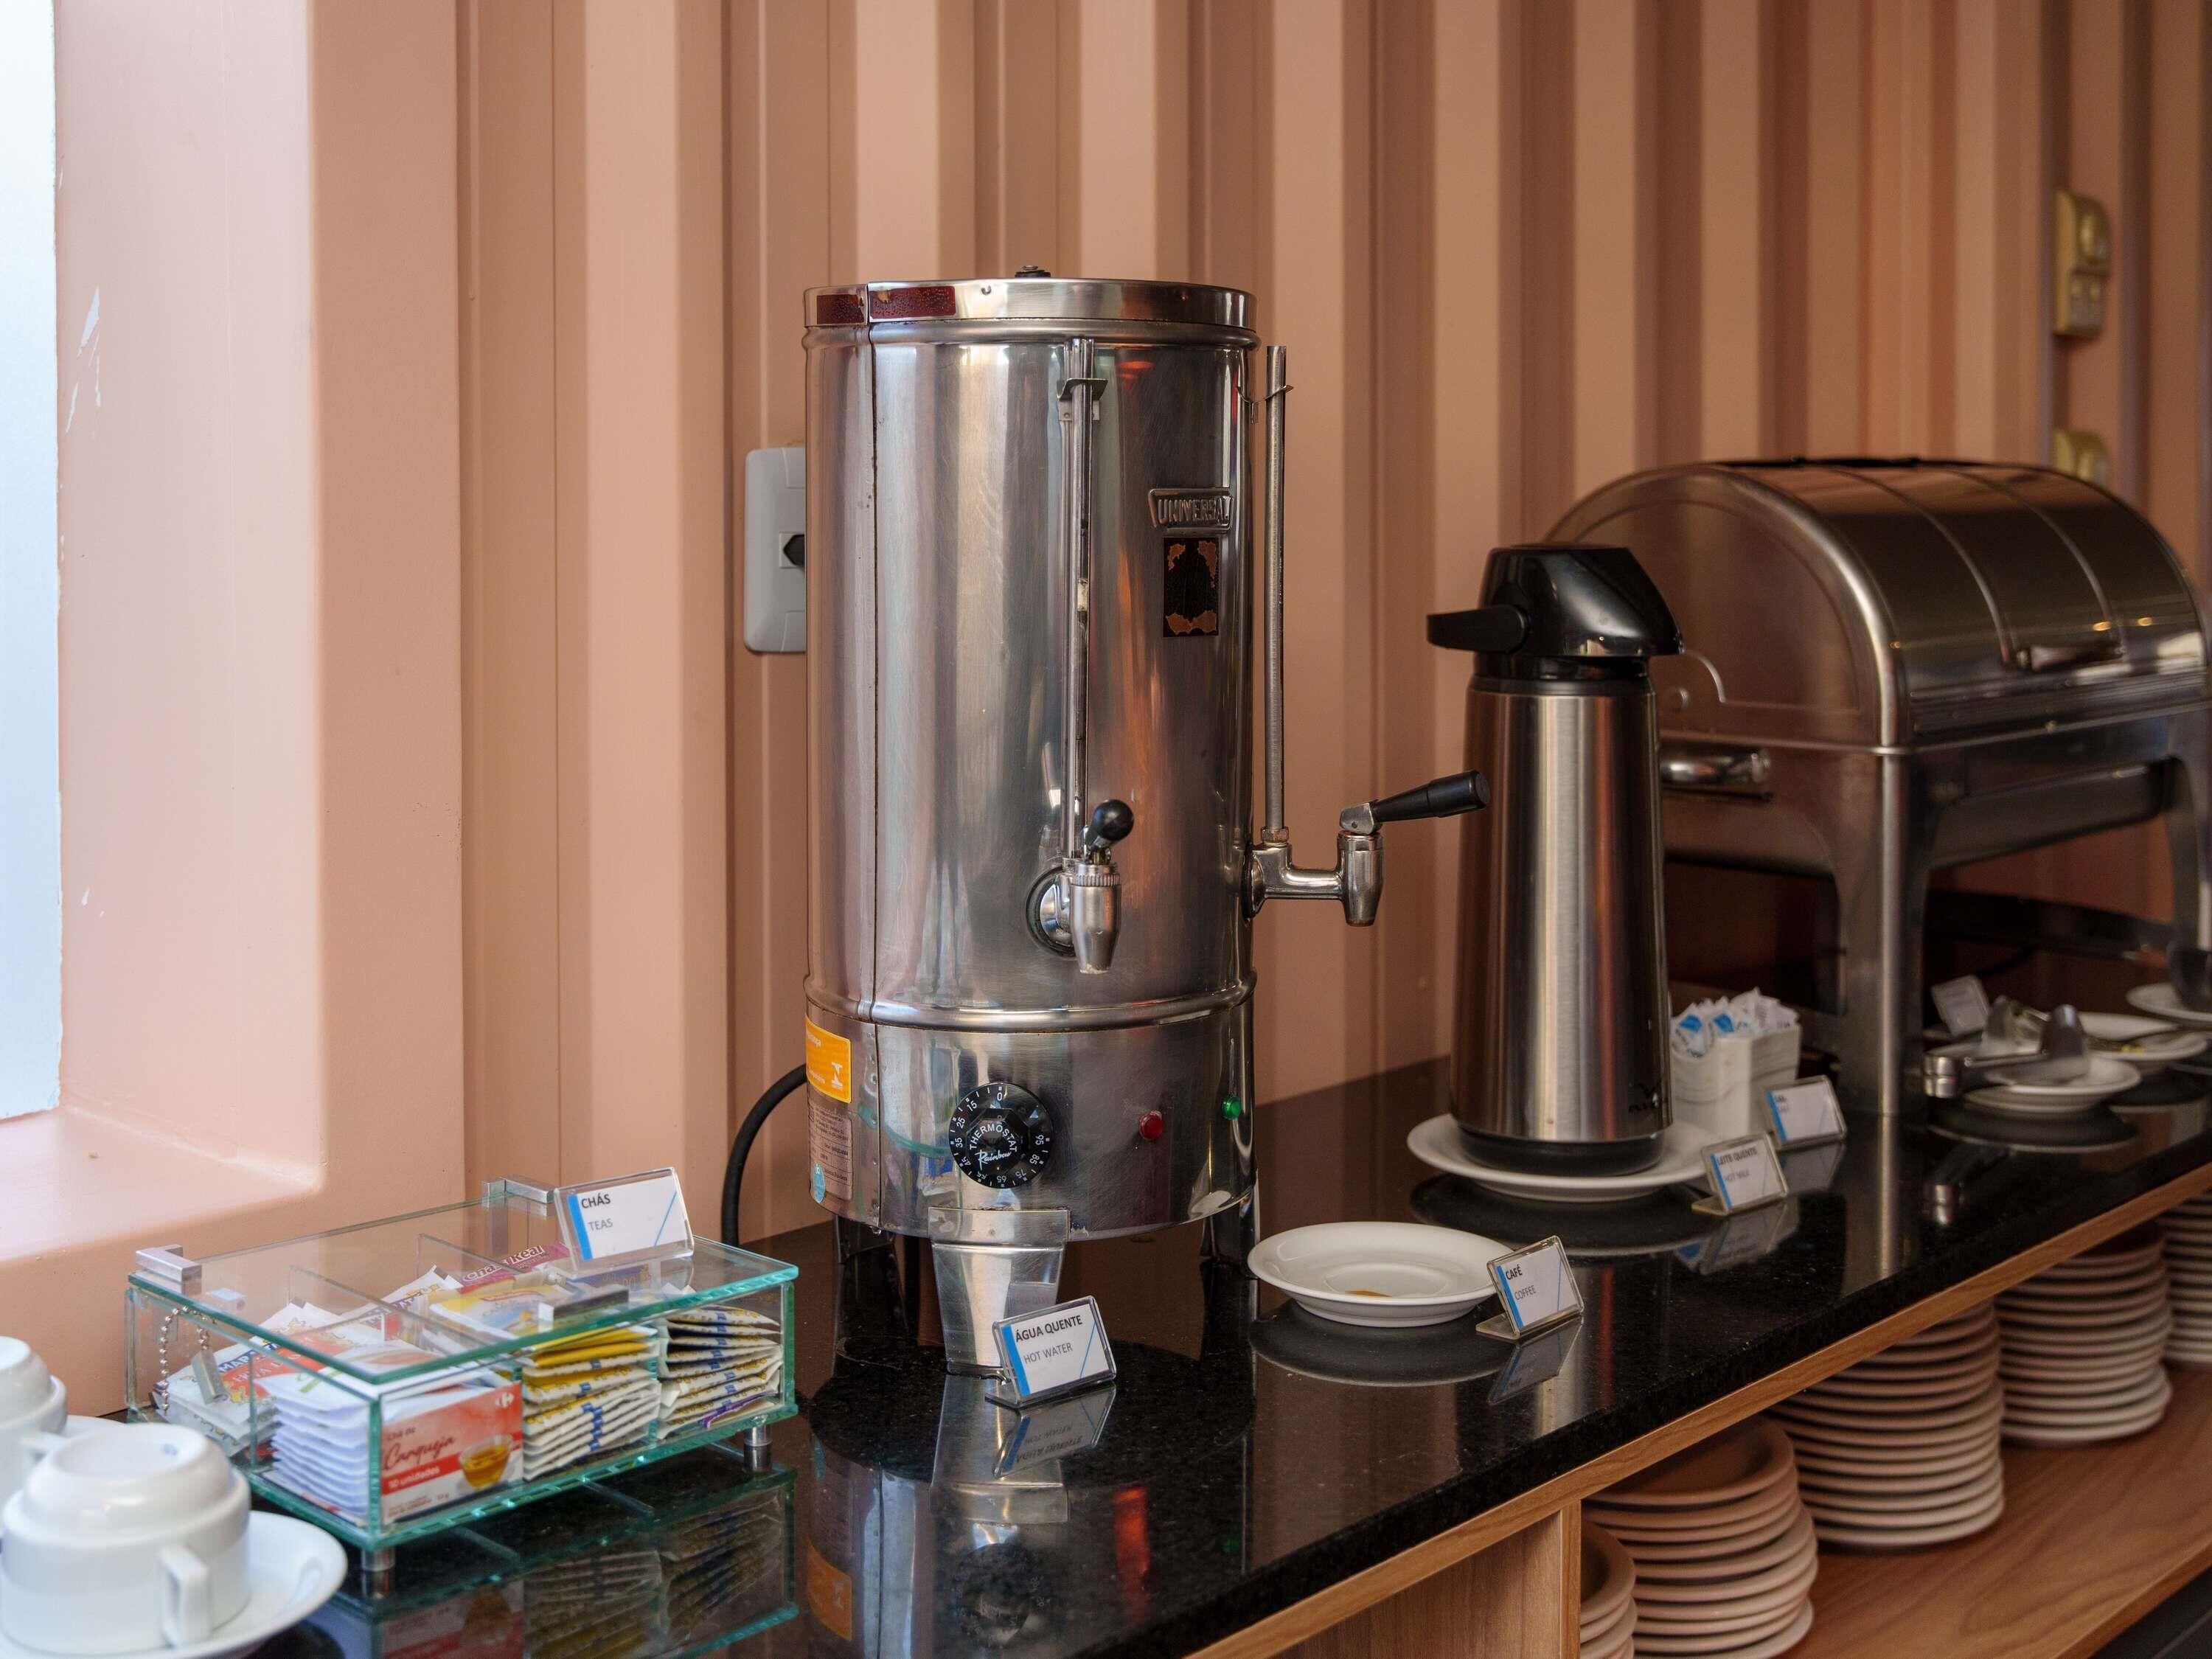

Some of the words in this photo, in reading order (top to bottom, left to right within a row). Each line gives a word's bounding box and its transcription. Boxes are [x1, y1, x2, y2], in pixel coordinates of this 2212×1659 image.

[997, 1092, 1003, 1102] 0
[967, 1101, 977, 1112] 15
[956, 1117, 966, 1129] 25
[956, 1137, 963, 1148] 35
[970, 1123, 1018, 1152] THERMOSTAT
[1035, 1134, 1044, 1146] 95
[975, 1150, 1012, 1171] Rainbow
[1029, 1154, 1040, 1165] 85
[1717, 1154, 1733, 1166] LEITE
[1733, 1147, 1758, 1161] QUENTE
[581, 1192, 611, 1209] CHÁS
[588, 1217, 613, 1232] TEAS
[1506, 1264, 1523, 1280] CAFÉ
[1514, 1284, 1537, 1301] COFFEE
[1015, 1326, 1044, 1342] ÁGUA
[1044, 1315, 1083, 1333] QUENTE
[1023, 1352, 1042, 1365] HOT
[1043, 1342, 1074, 1359] WATER
